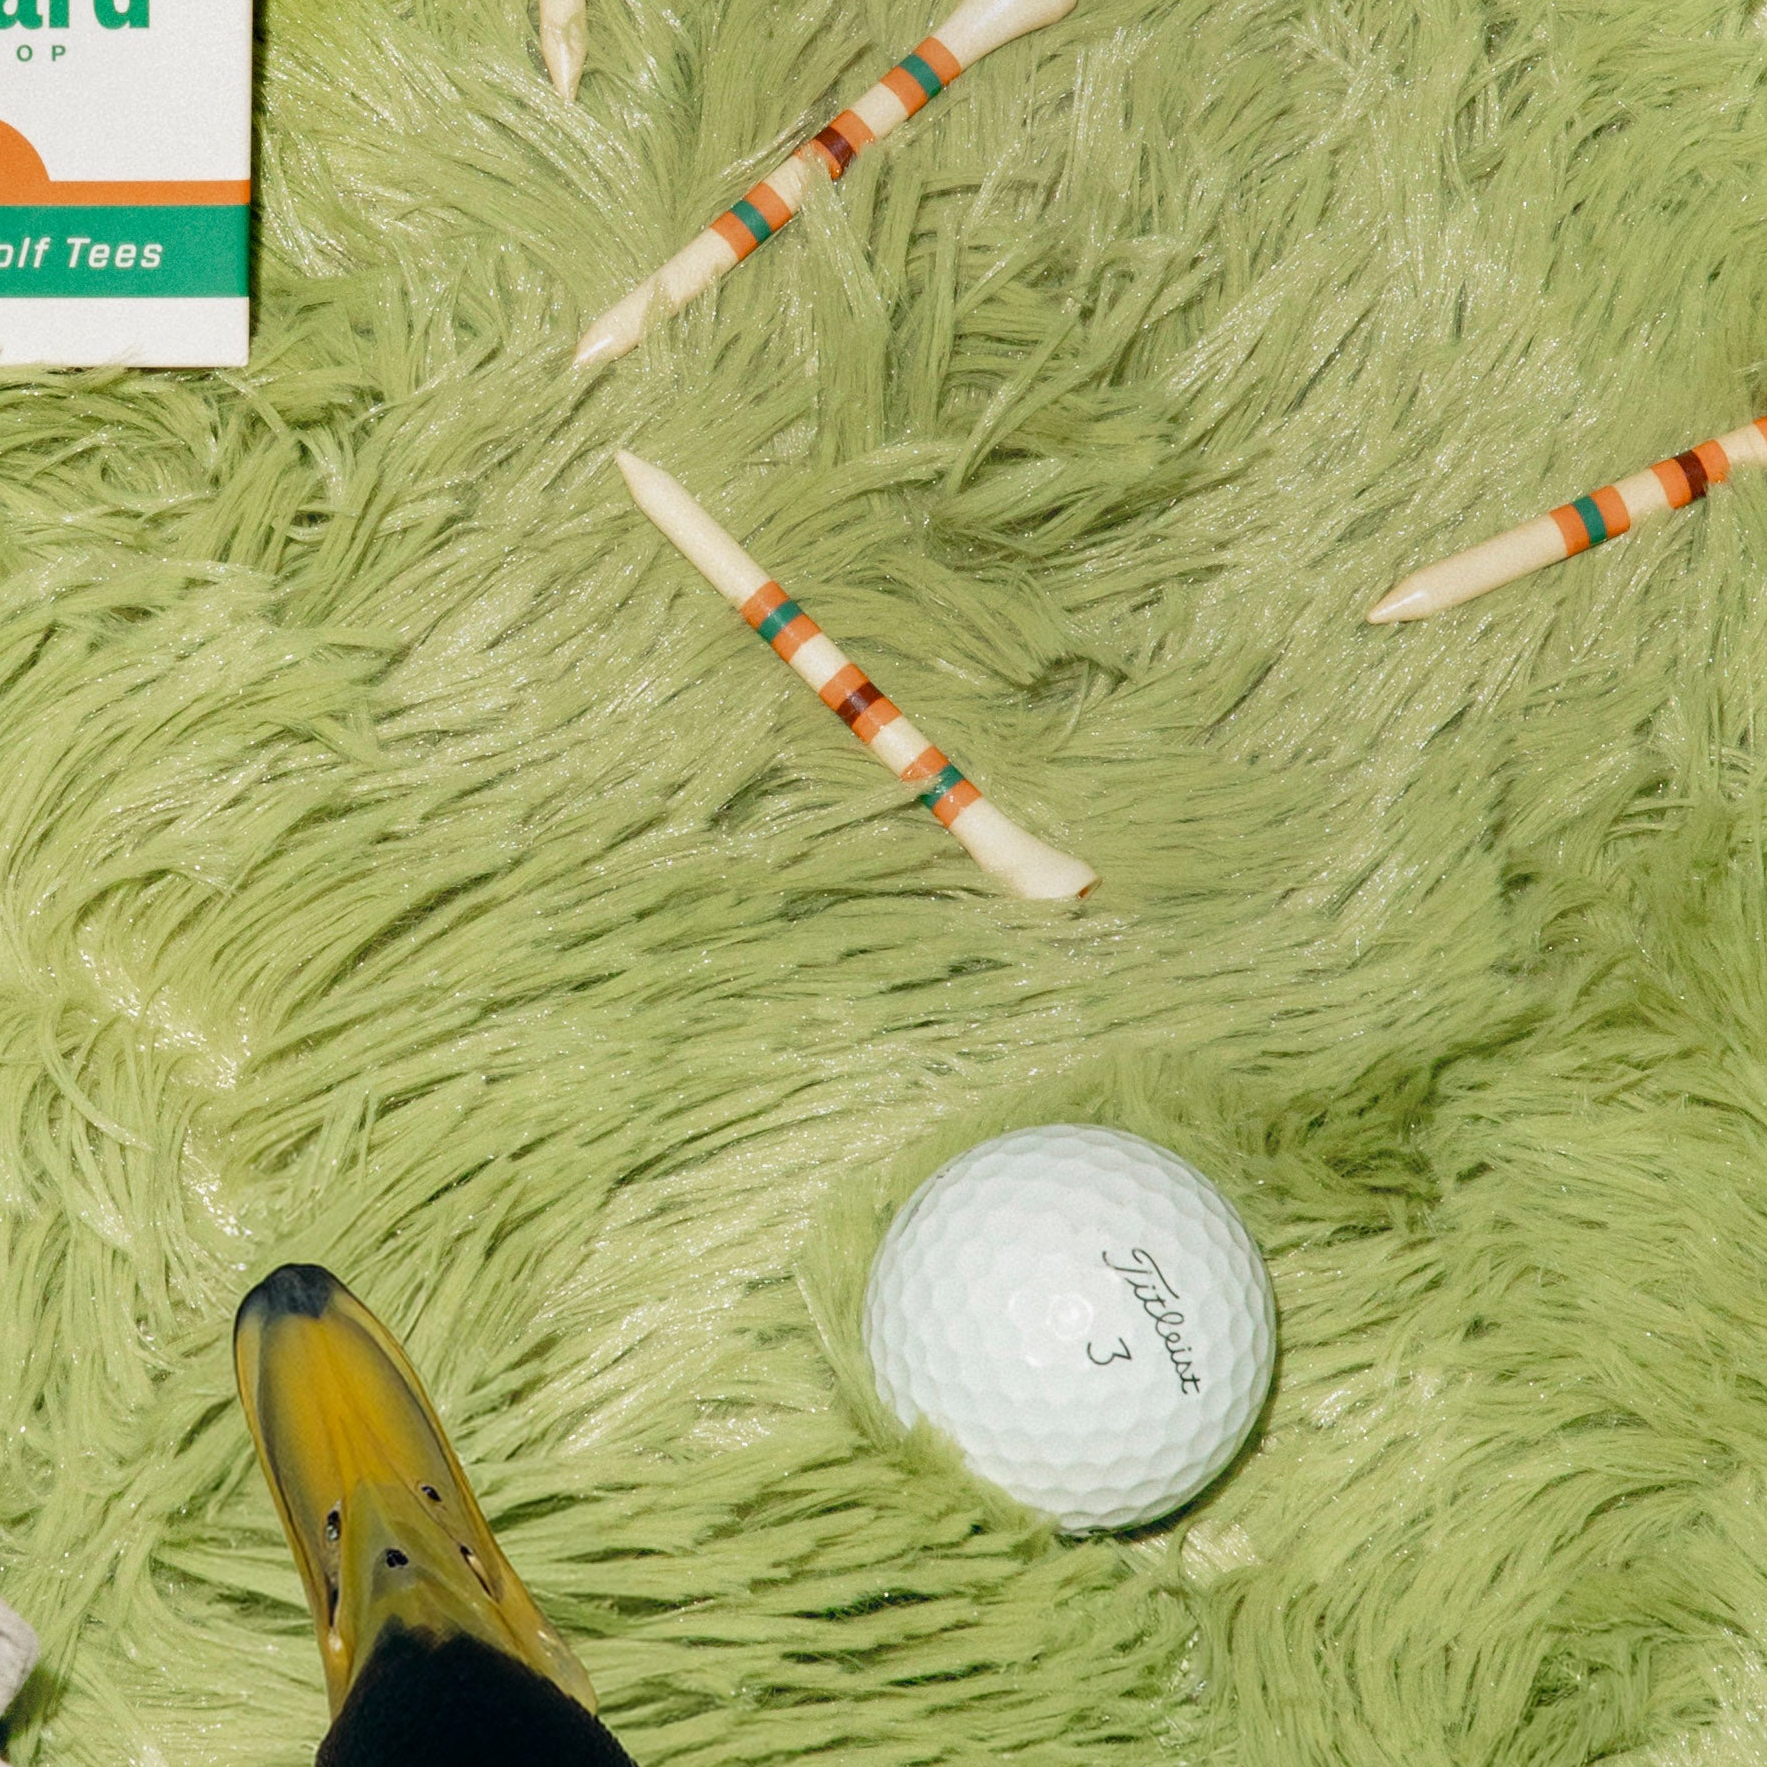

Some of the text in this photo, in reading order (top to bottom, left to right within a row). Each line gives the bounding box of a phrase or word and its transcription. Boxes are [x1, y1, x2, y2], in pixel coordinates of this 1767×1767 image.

[65, 237, 164, 269] Tees
[1101, 1247, 1201, 1395] Titleist
[1086, 1336, 1132, 1366] 3
